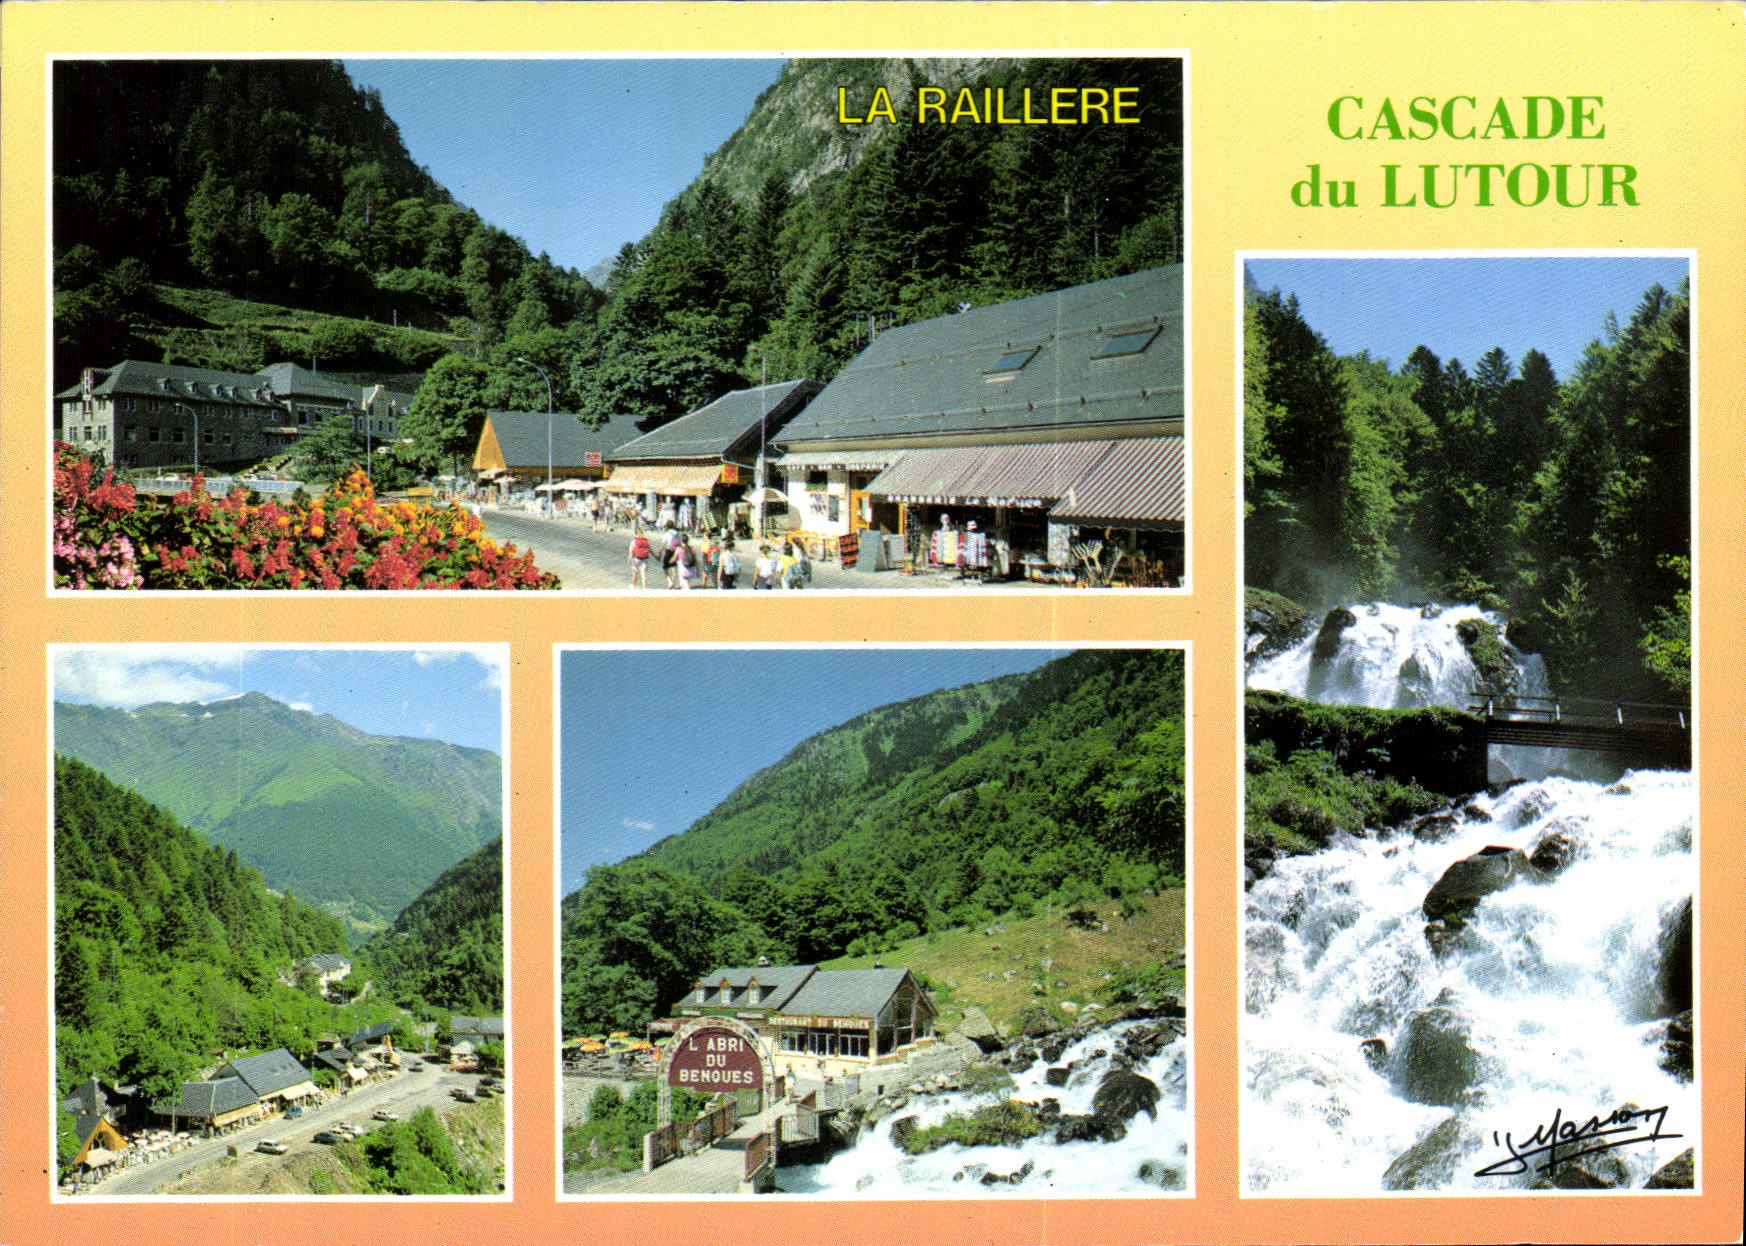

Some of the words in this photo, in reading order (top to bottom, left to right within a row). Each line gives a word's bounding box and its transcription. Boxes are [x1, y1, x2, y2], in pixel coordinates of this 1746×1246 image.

[689, 1037, 698, 1051] L
[707, 1038, 744, 1052] ABRI
[706, 1053, 726, 1067] DU
